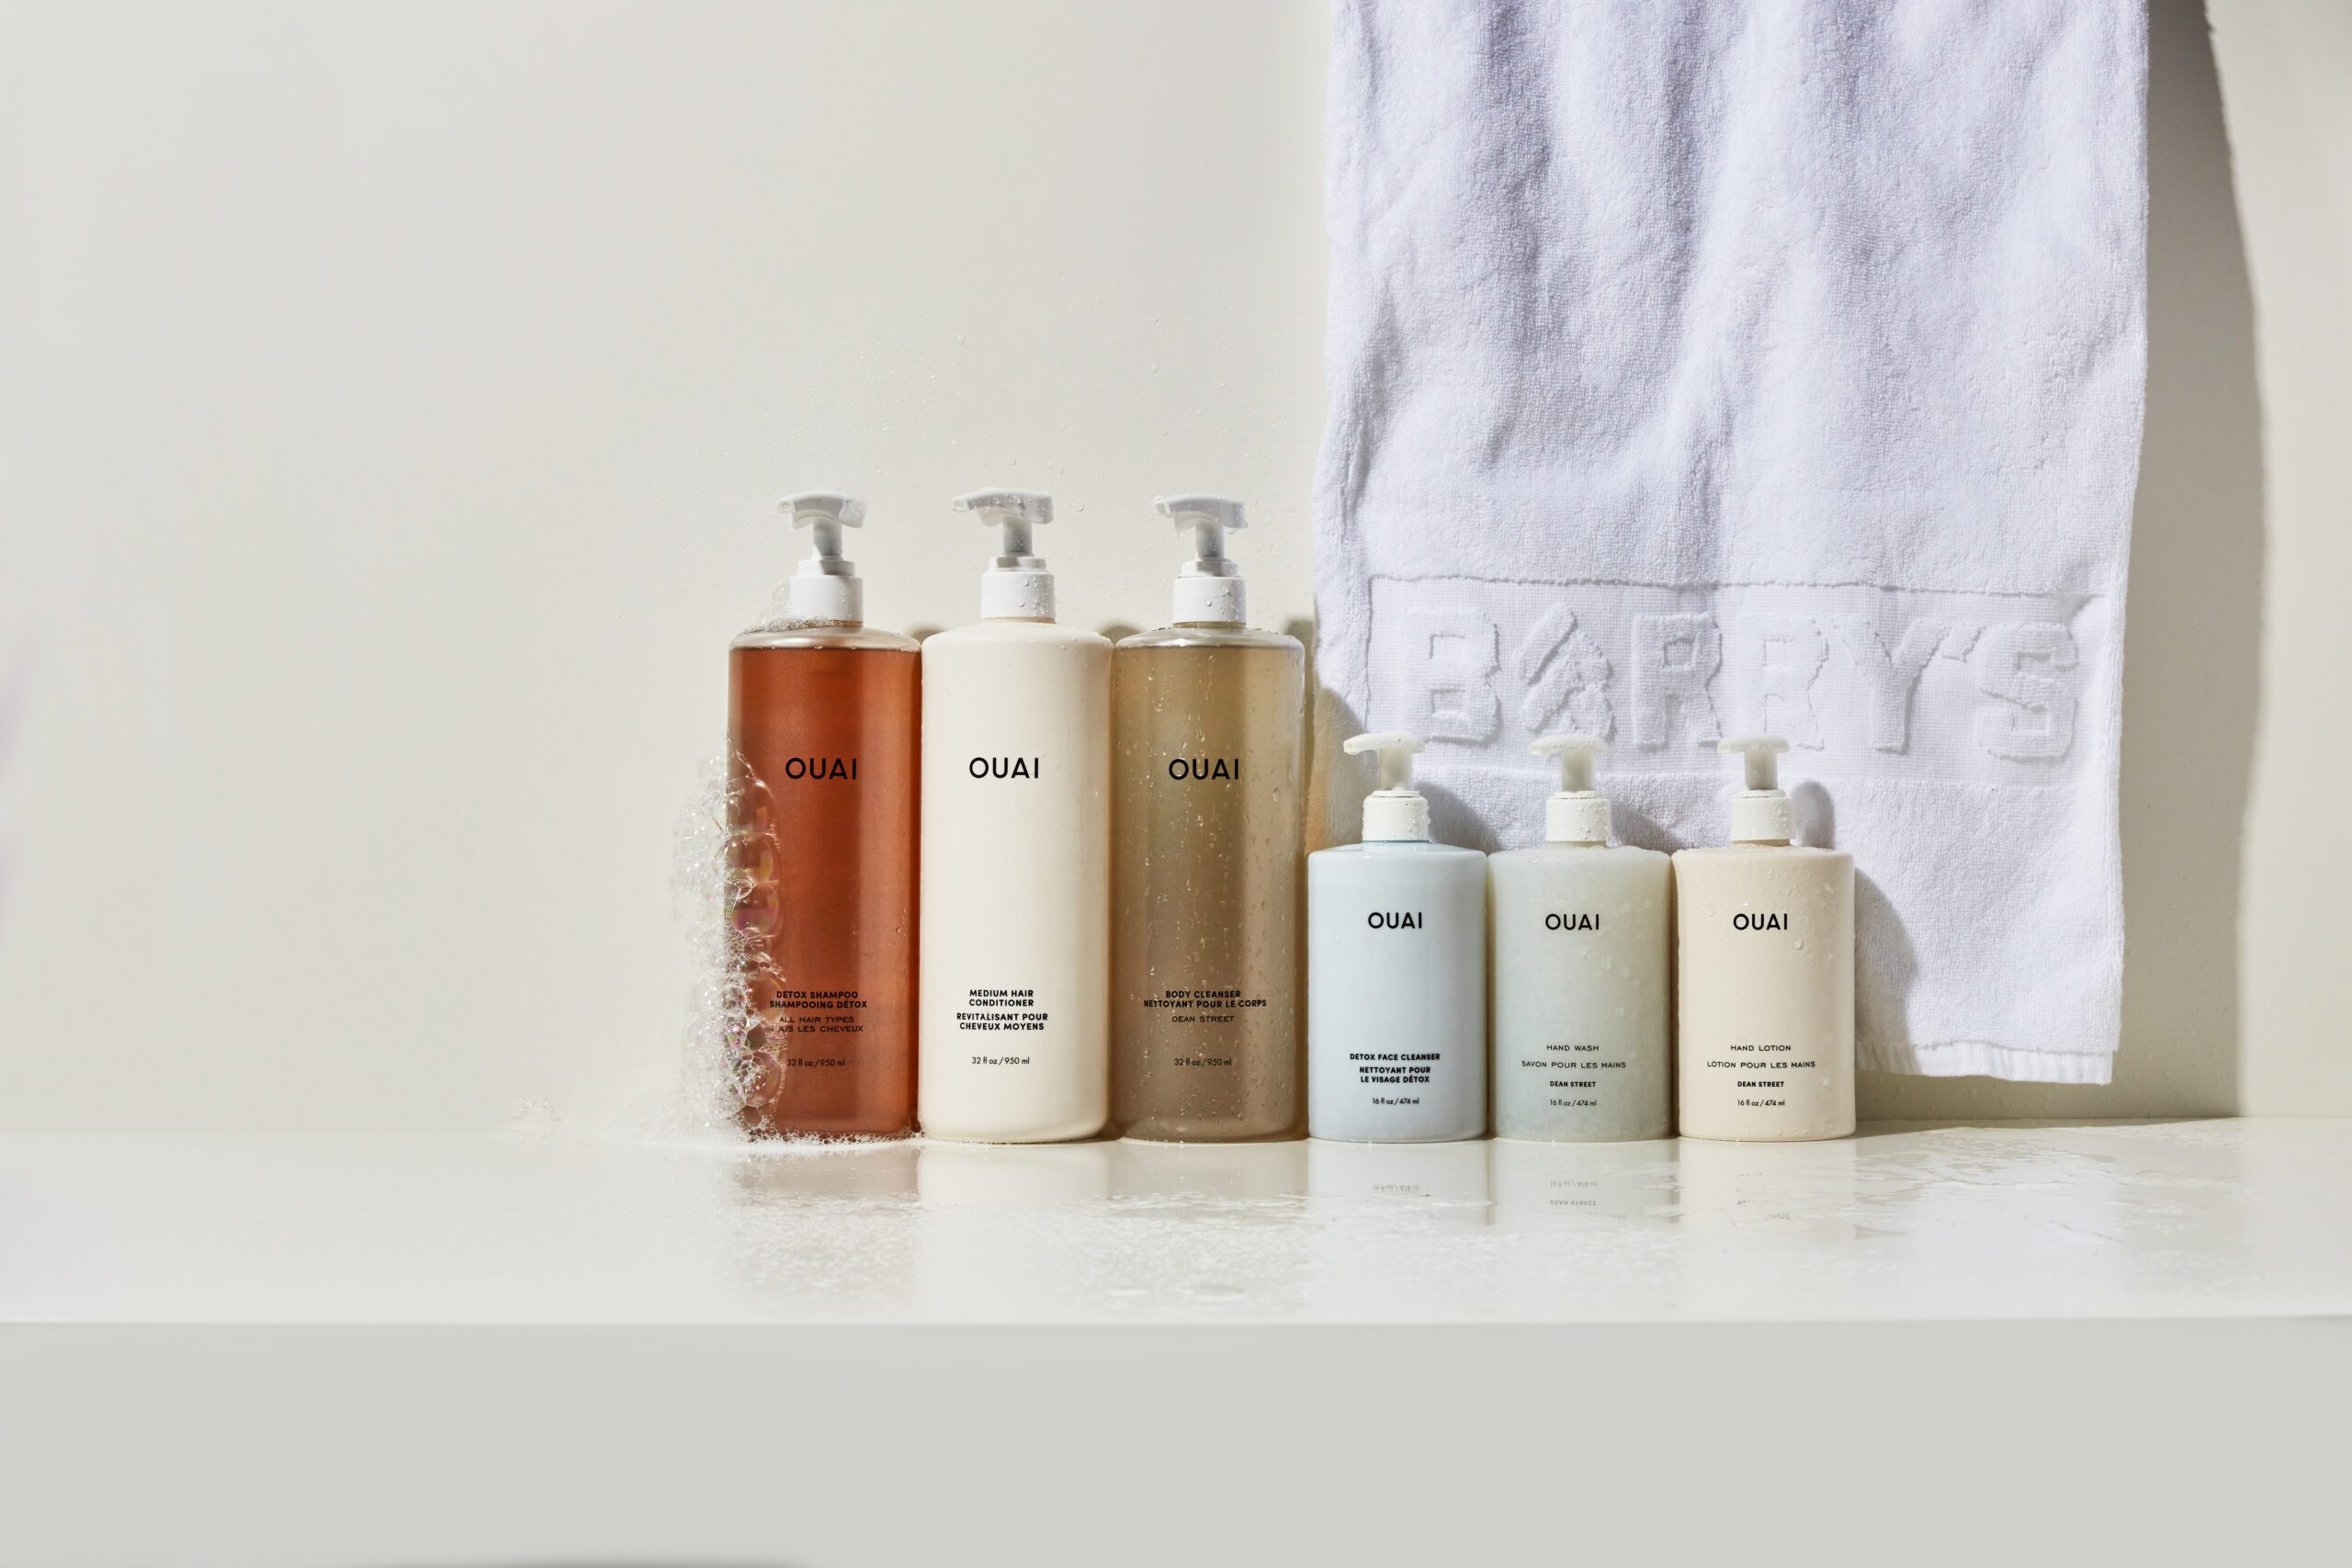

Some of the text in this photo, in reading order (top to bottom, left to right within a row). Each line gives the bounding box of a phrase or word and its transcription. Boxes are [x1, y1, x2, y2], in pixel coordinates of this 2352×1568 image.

[786, 758, 857, 780] OUAI
[968, 758, 1039, 779] OUAI
[1169, 758, 1239, 780] OUAI
[1367, 912, 1422, 930] OUAI
[1545, 913, 1600, 931] OUAI
[1733, 913, 1788, 931] OUAI
[837, 999, 867, 1009] DÉTOX
[814, 1059, 820, 1067] /
[999, 1057, 1004, 1066] /
